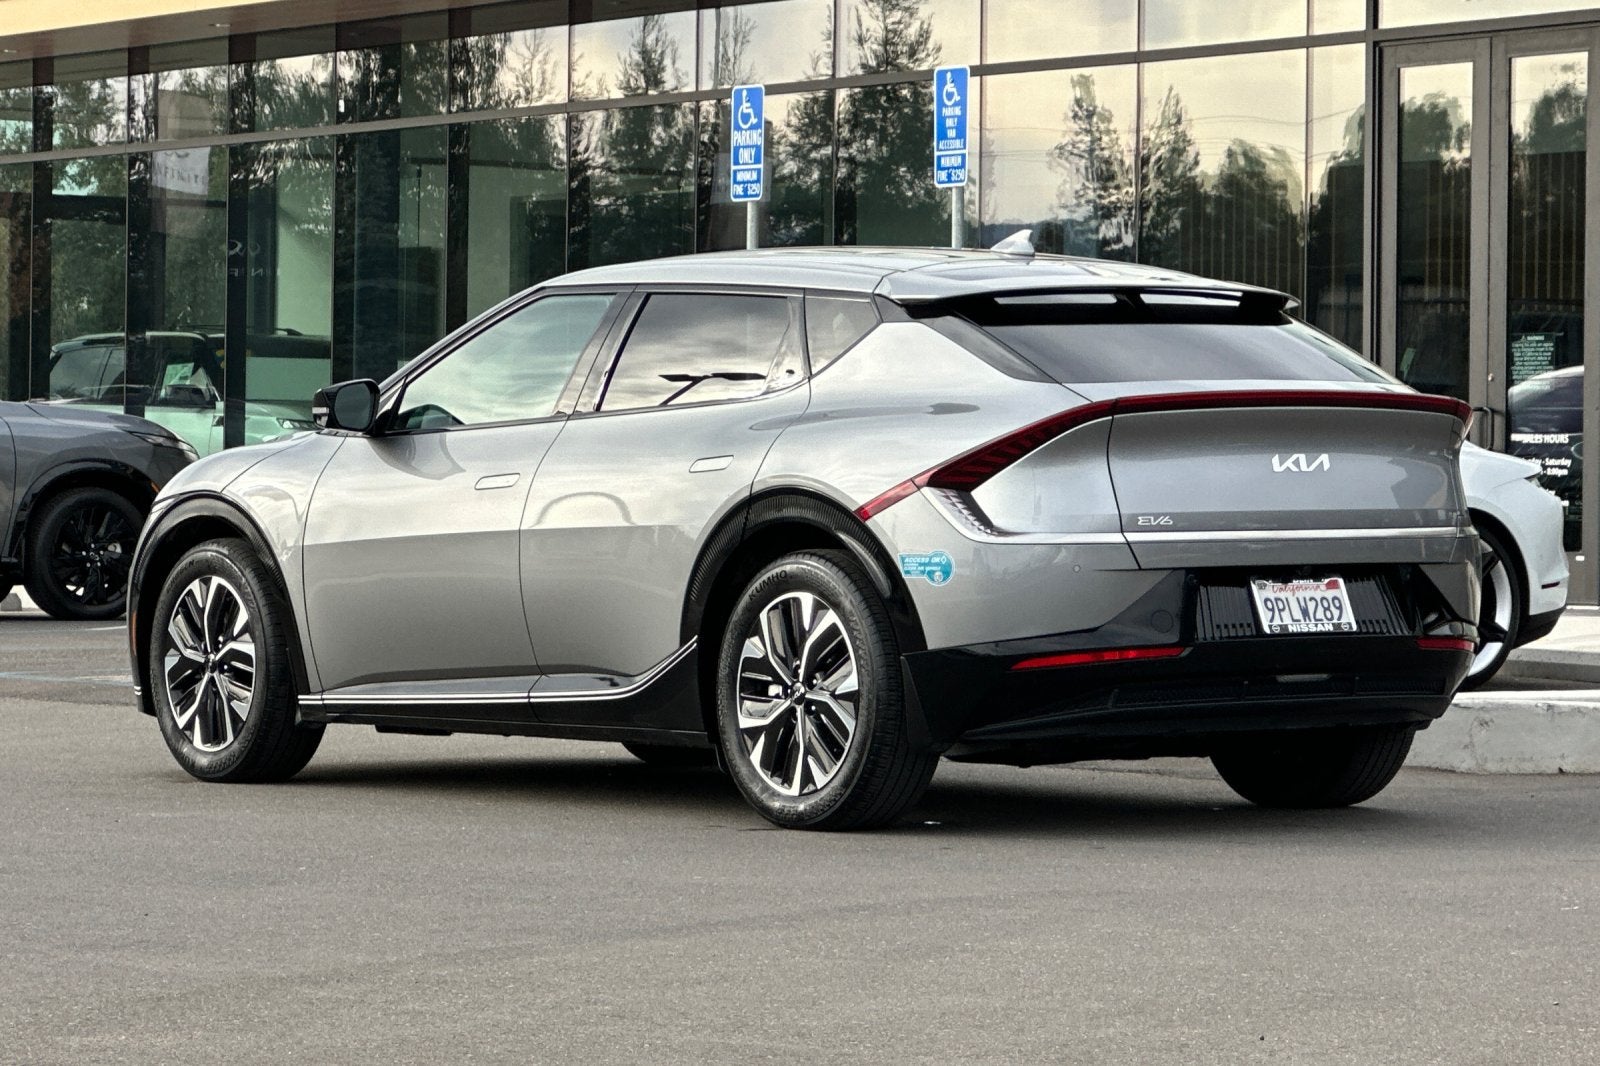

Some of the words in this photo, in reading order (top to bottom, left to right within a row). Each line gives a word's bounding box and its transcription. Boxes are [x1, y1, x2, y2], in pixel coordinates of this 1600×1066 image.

[733, 129, 762, 147] PARKING
[738, 147, 756, 164] ONLY
[733, 184, 744, 196] FINE
[1544, 433, 1569, 444] HOURS
[1545, 457, 1572, 468] Saturday
[1137, 515, 1174, 526] EV6
[748, 569, 788, 601] KUMHO
[1263, 595, 1344, 623] 9PLW289
[1287, 623, 1334, 633] NISSAN
